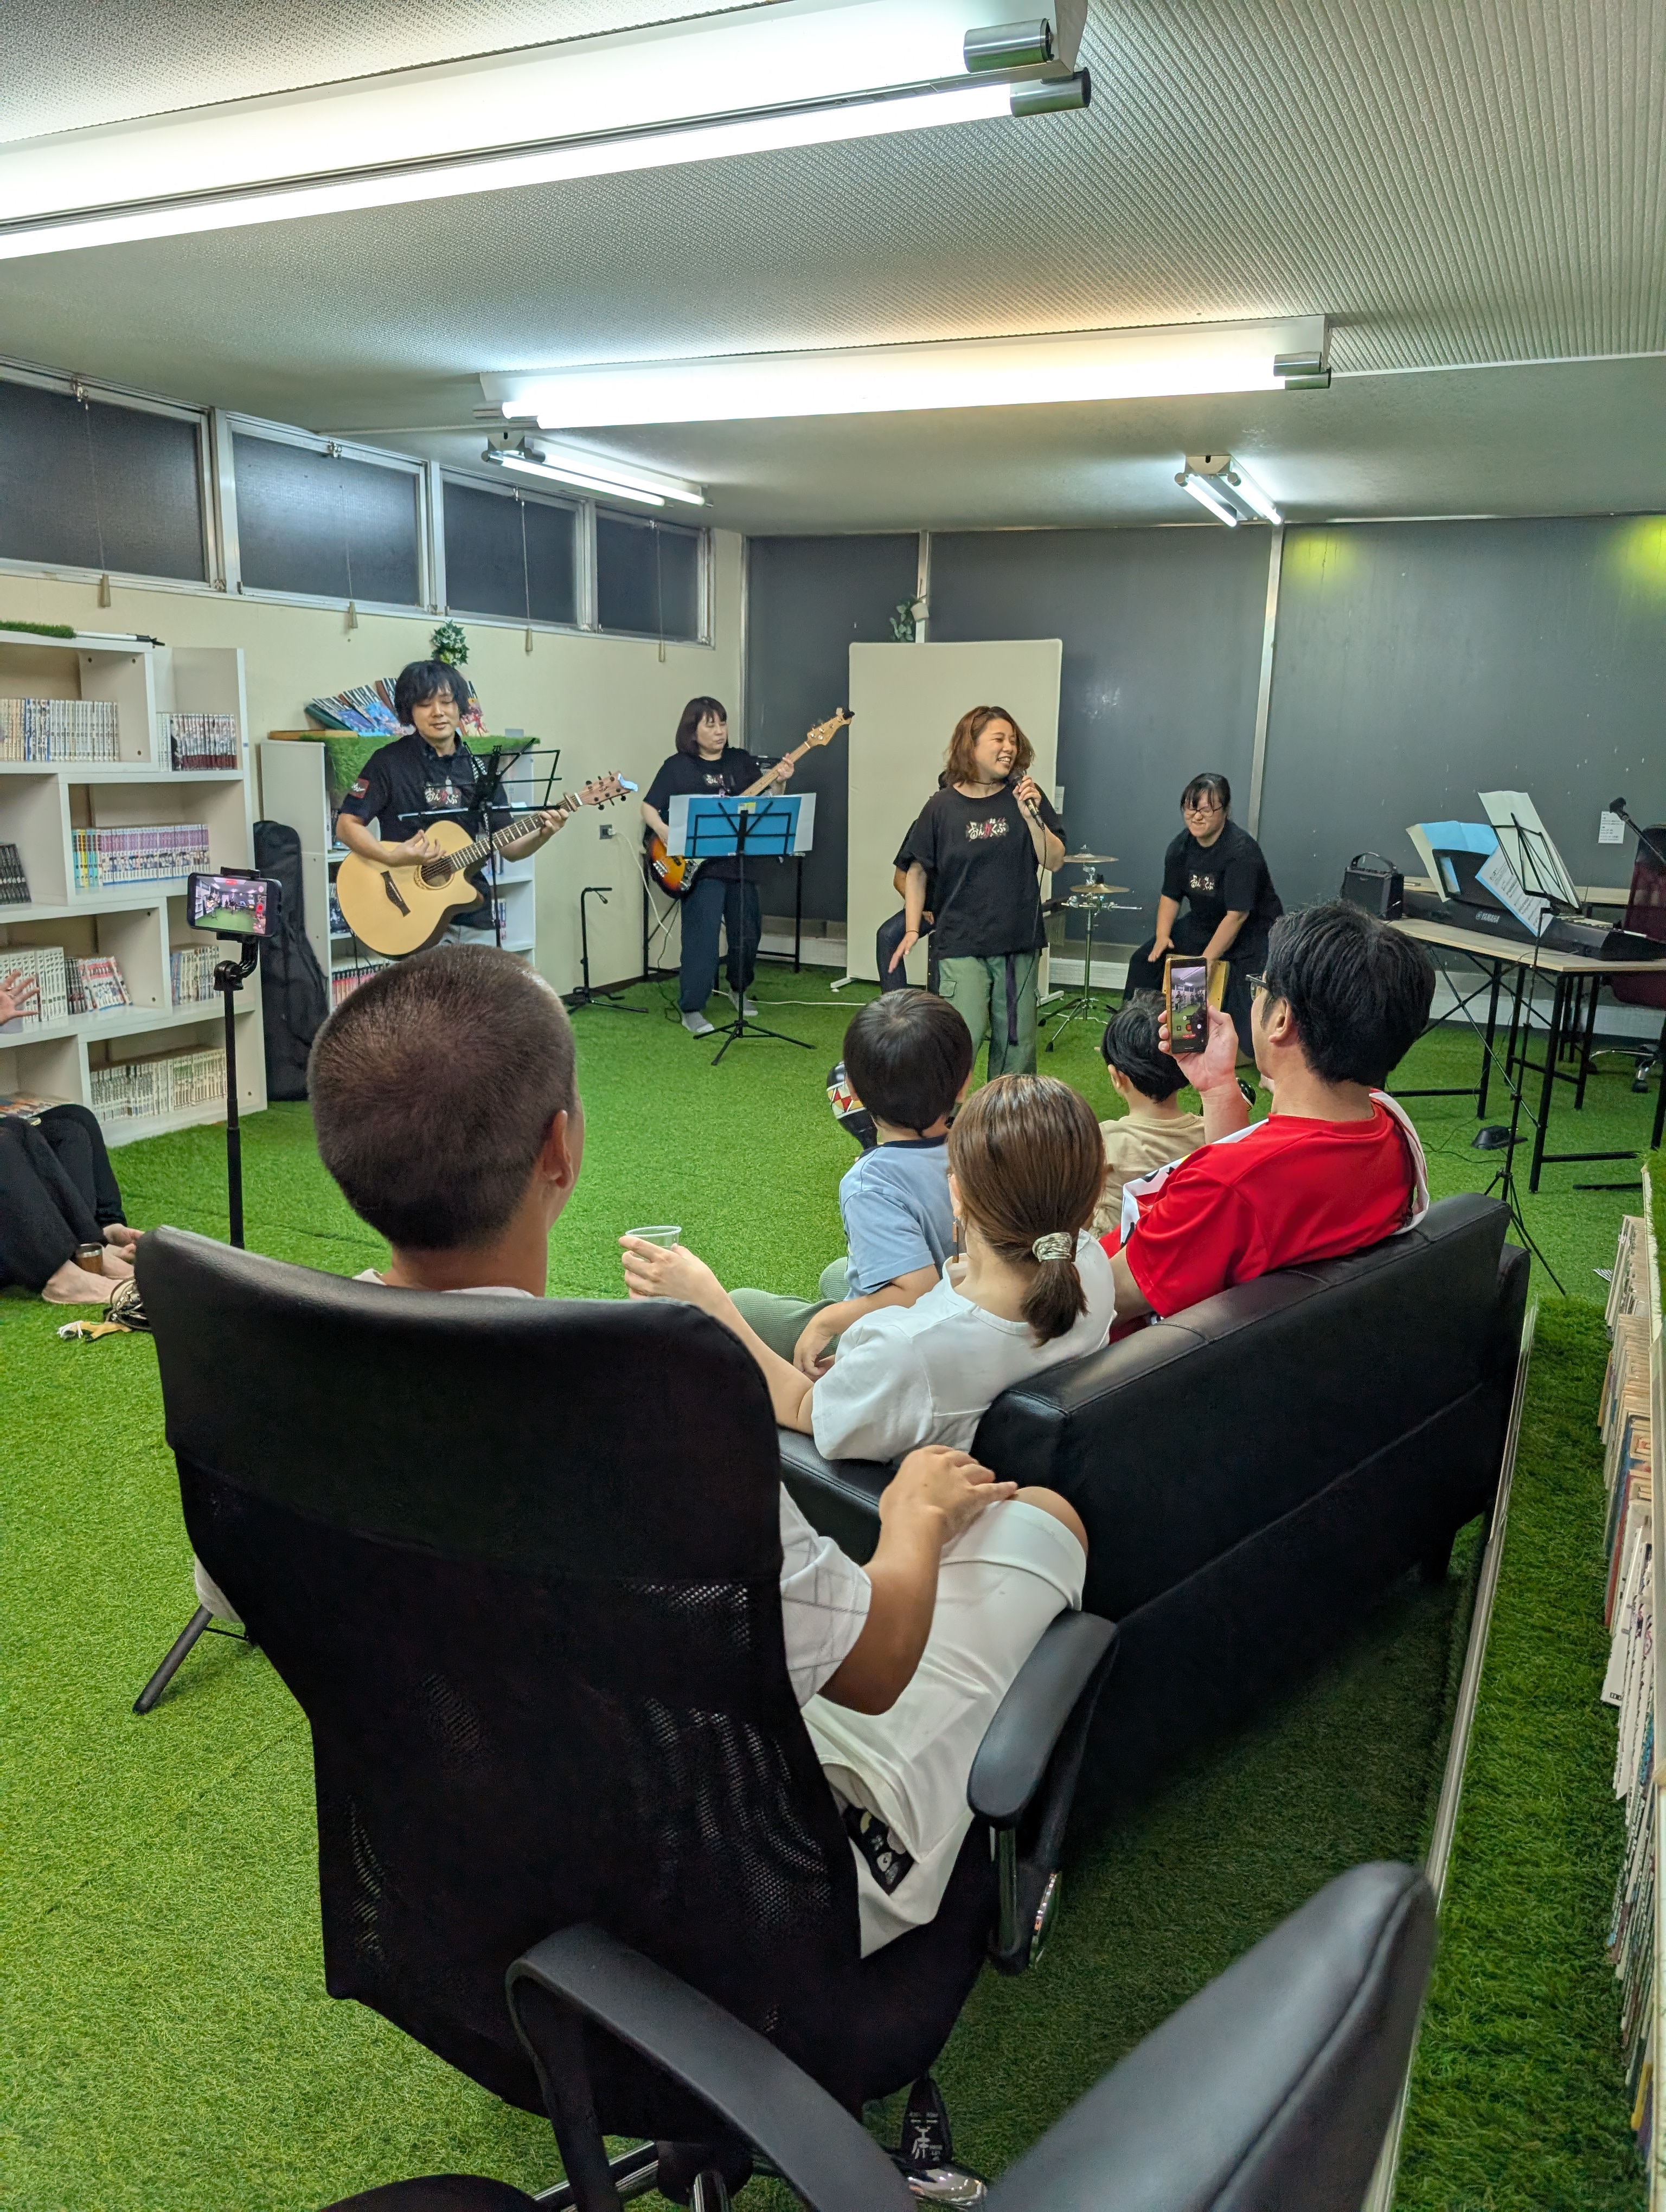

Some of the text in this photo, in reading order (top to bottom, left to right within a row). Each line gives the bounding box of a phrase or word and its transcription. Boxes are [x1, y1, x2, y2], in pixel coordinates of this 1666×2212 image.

[967, 818, 1007, 840] おんがくぶ
